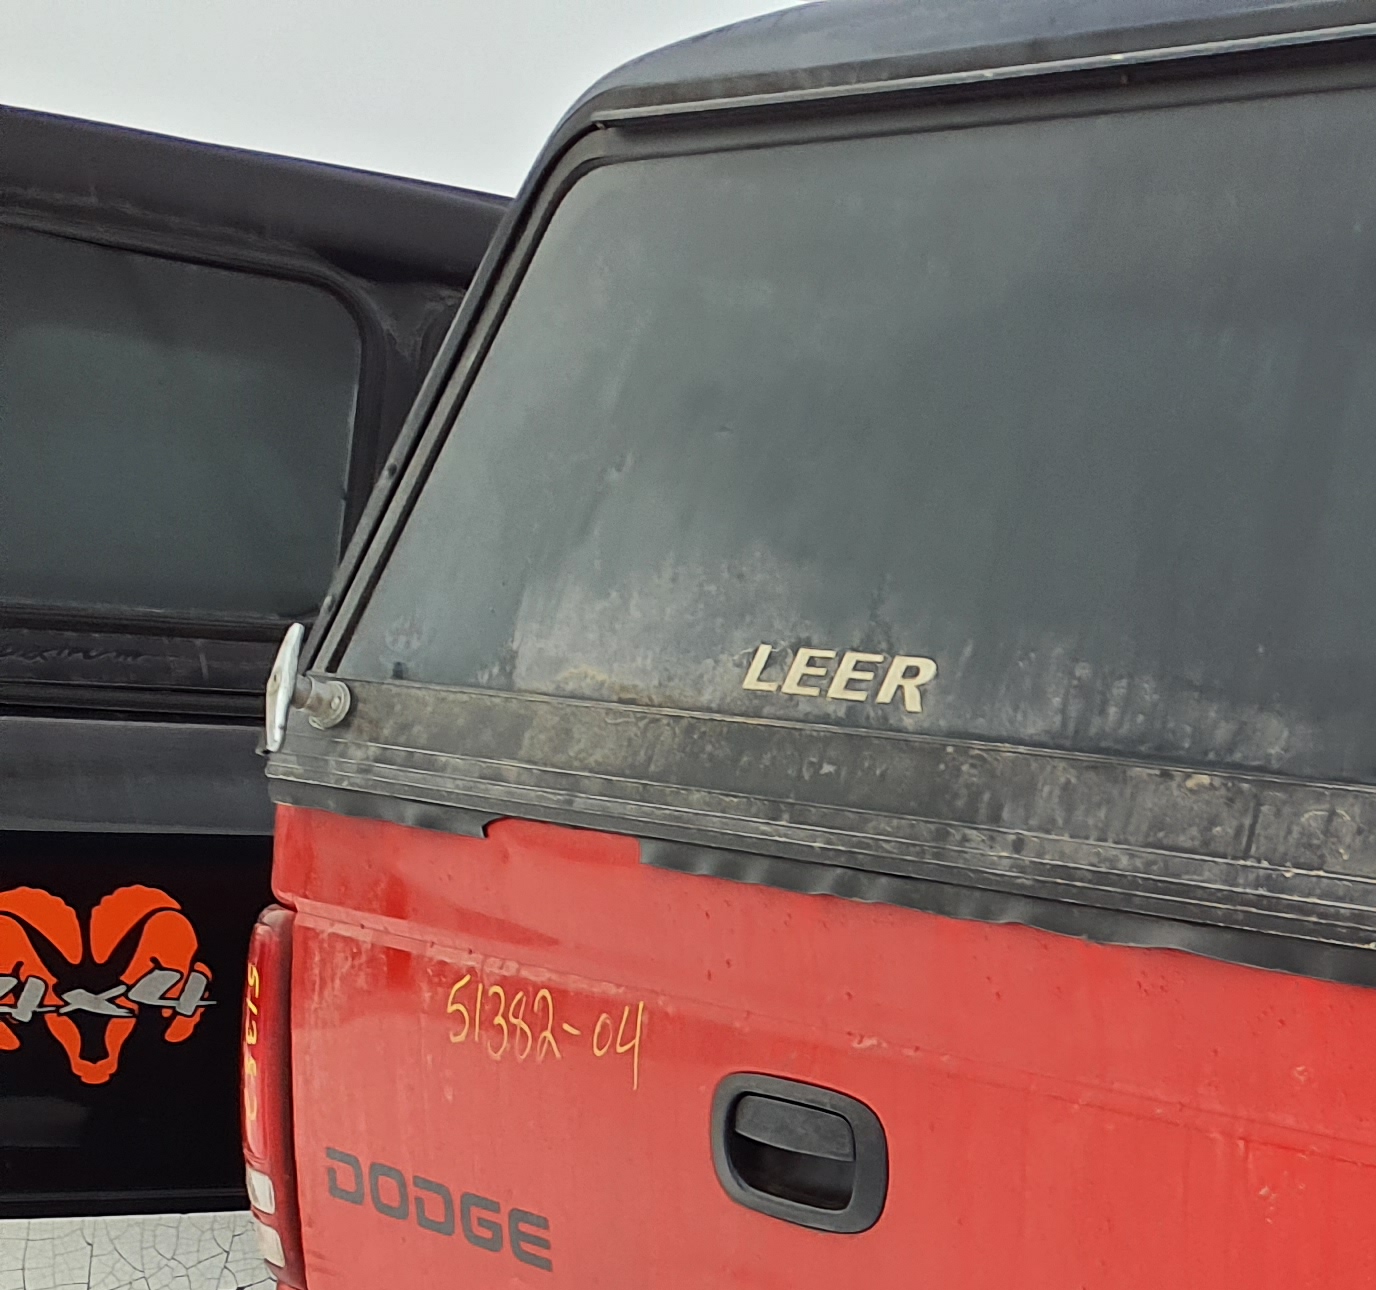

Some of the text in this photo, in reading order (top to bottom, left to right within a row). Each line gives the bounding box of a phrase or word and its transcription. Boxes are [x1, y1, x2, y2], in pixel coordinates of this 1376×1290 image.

[742, 643, 938, 713] LEER
[446, 974, 644, 1090] 51382-04
[325, 1146, 554, 1273] DODGE
